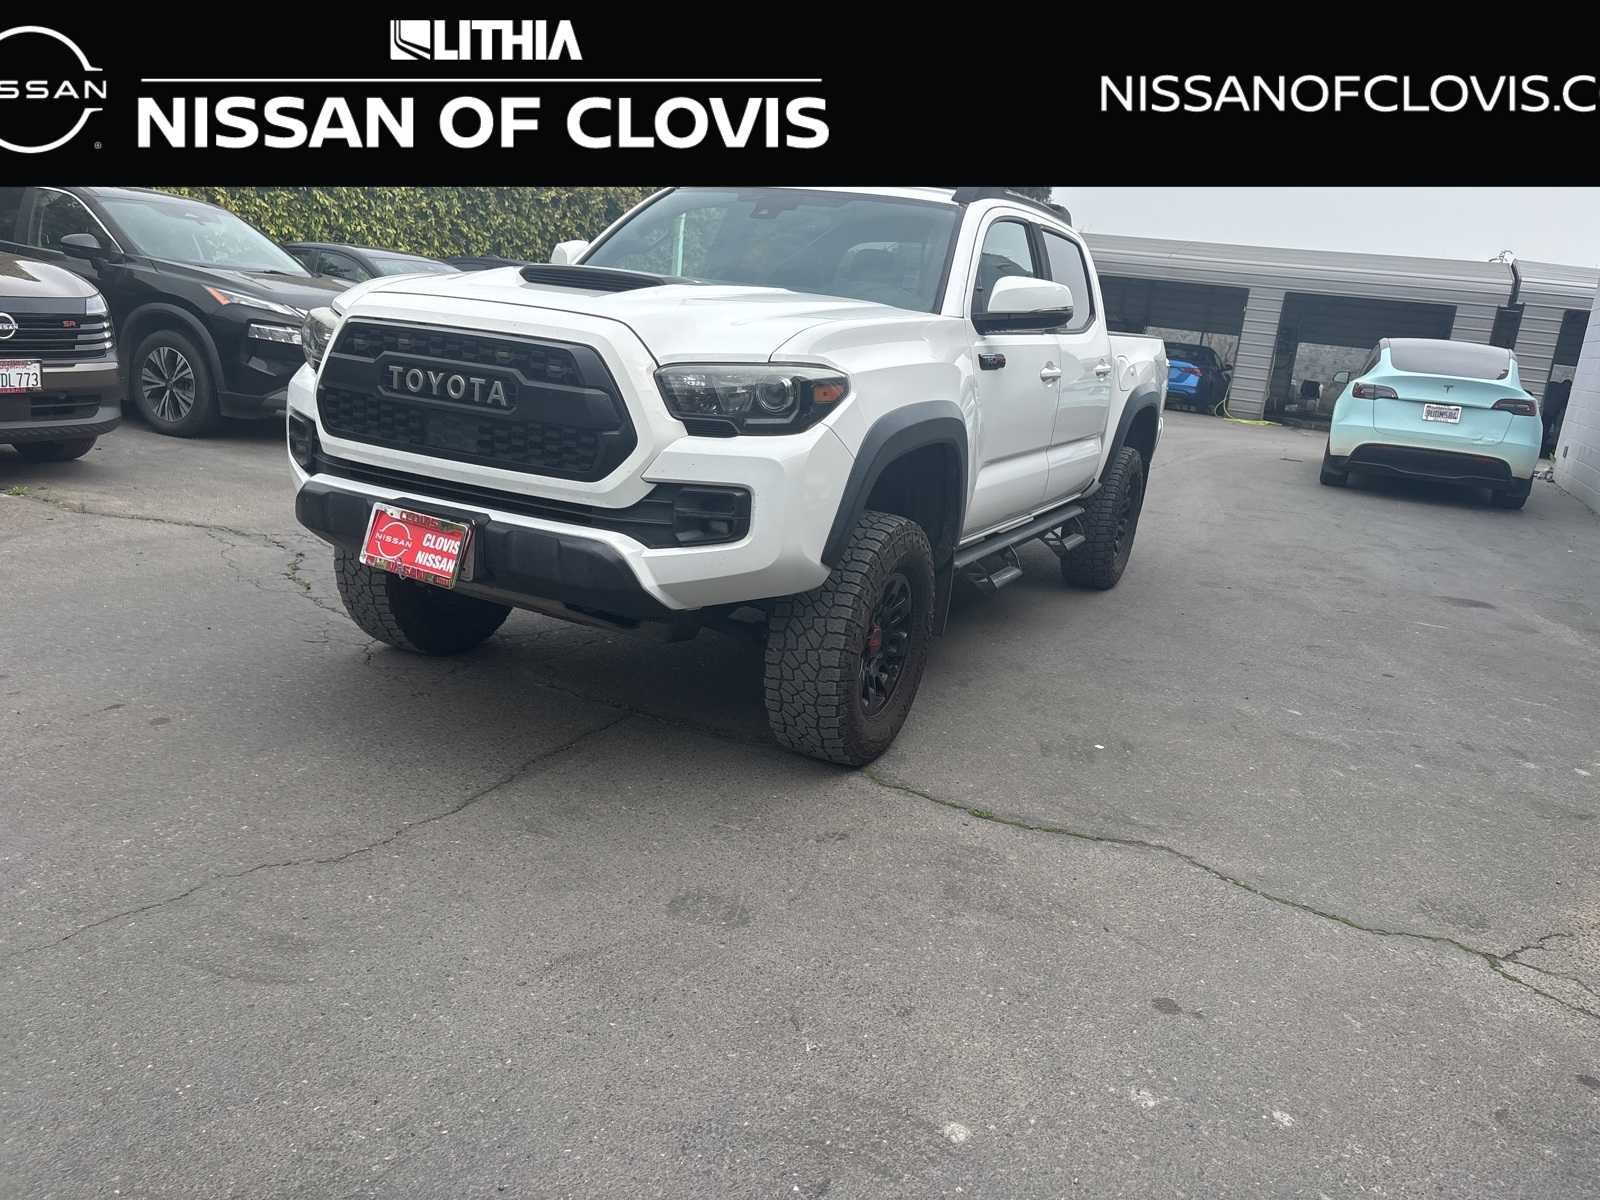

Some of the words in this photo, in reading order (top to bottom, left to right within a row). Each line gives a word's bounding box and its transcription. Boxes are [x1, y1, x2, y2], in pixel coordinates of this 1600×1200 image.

[388, 365, 508, 406] TOYOTA
[375, 532, 413, 549] NISSAN
[422, 533, 461, 554] CLOVIS
[414, 551, 456, 573] NISSAN
